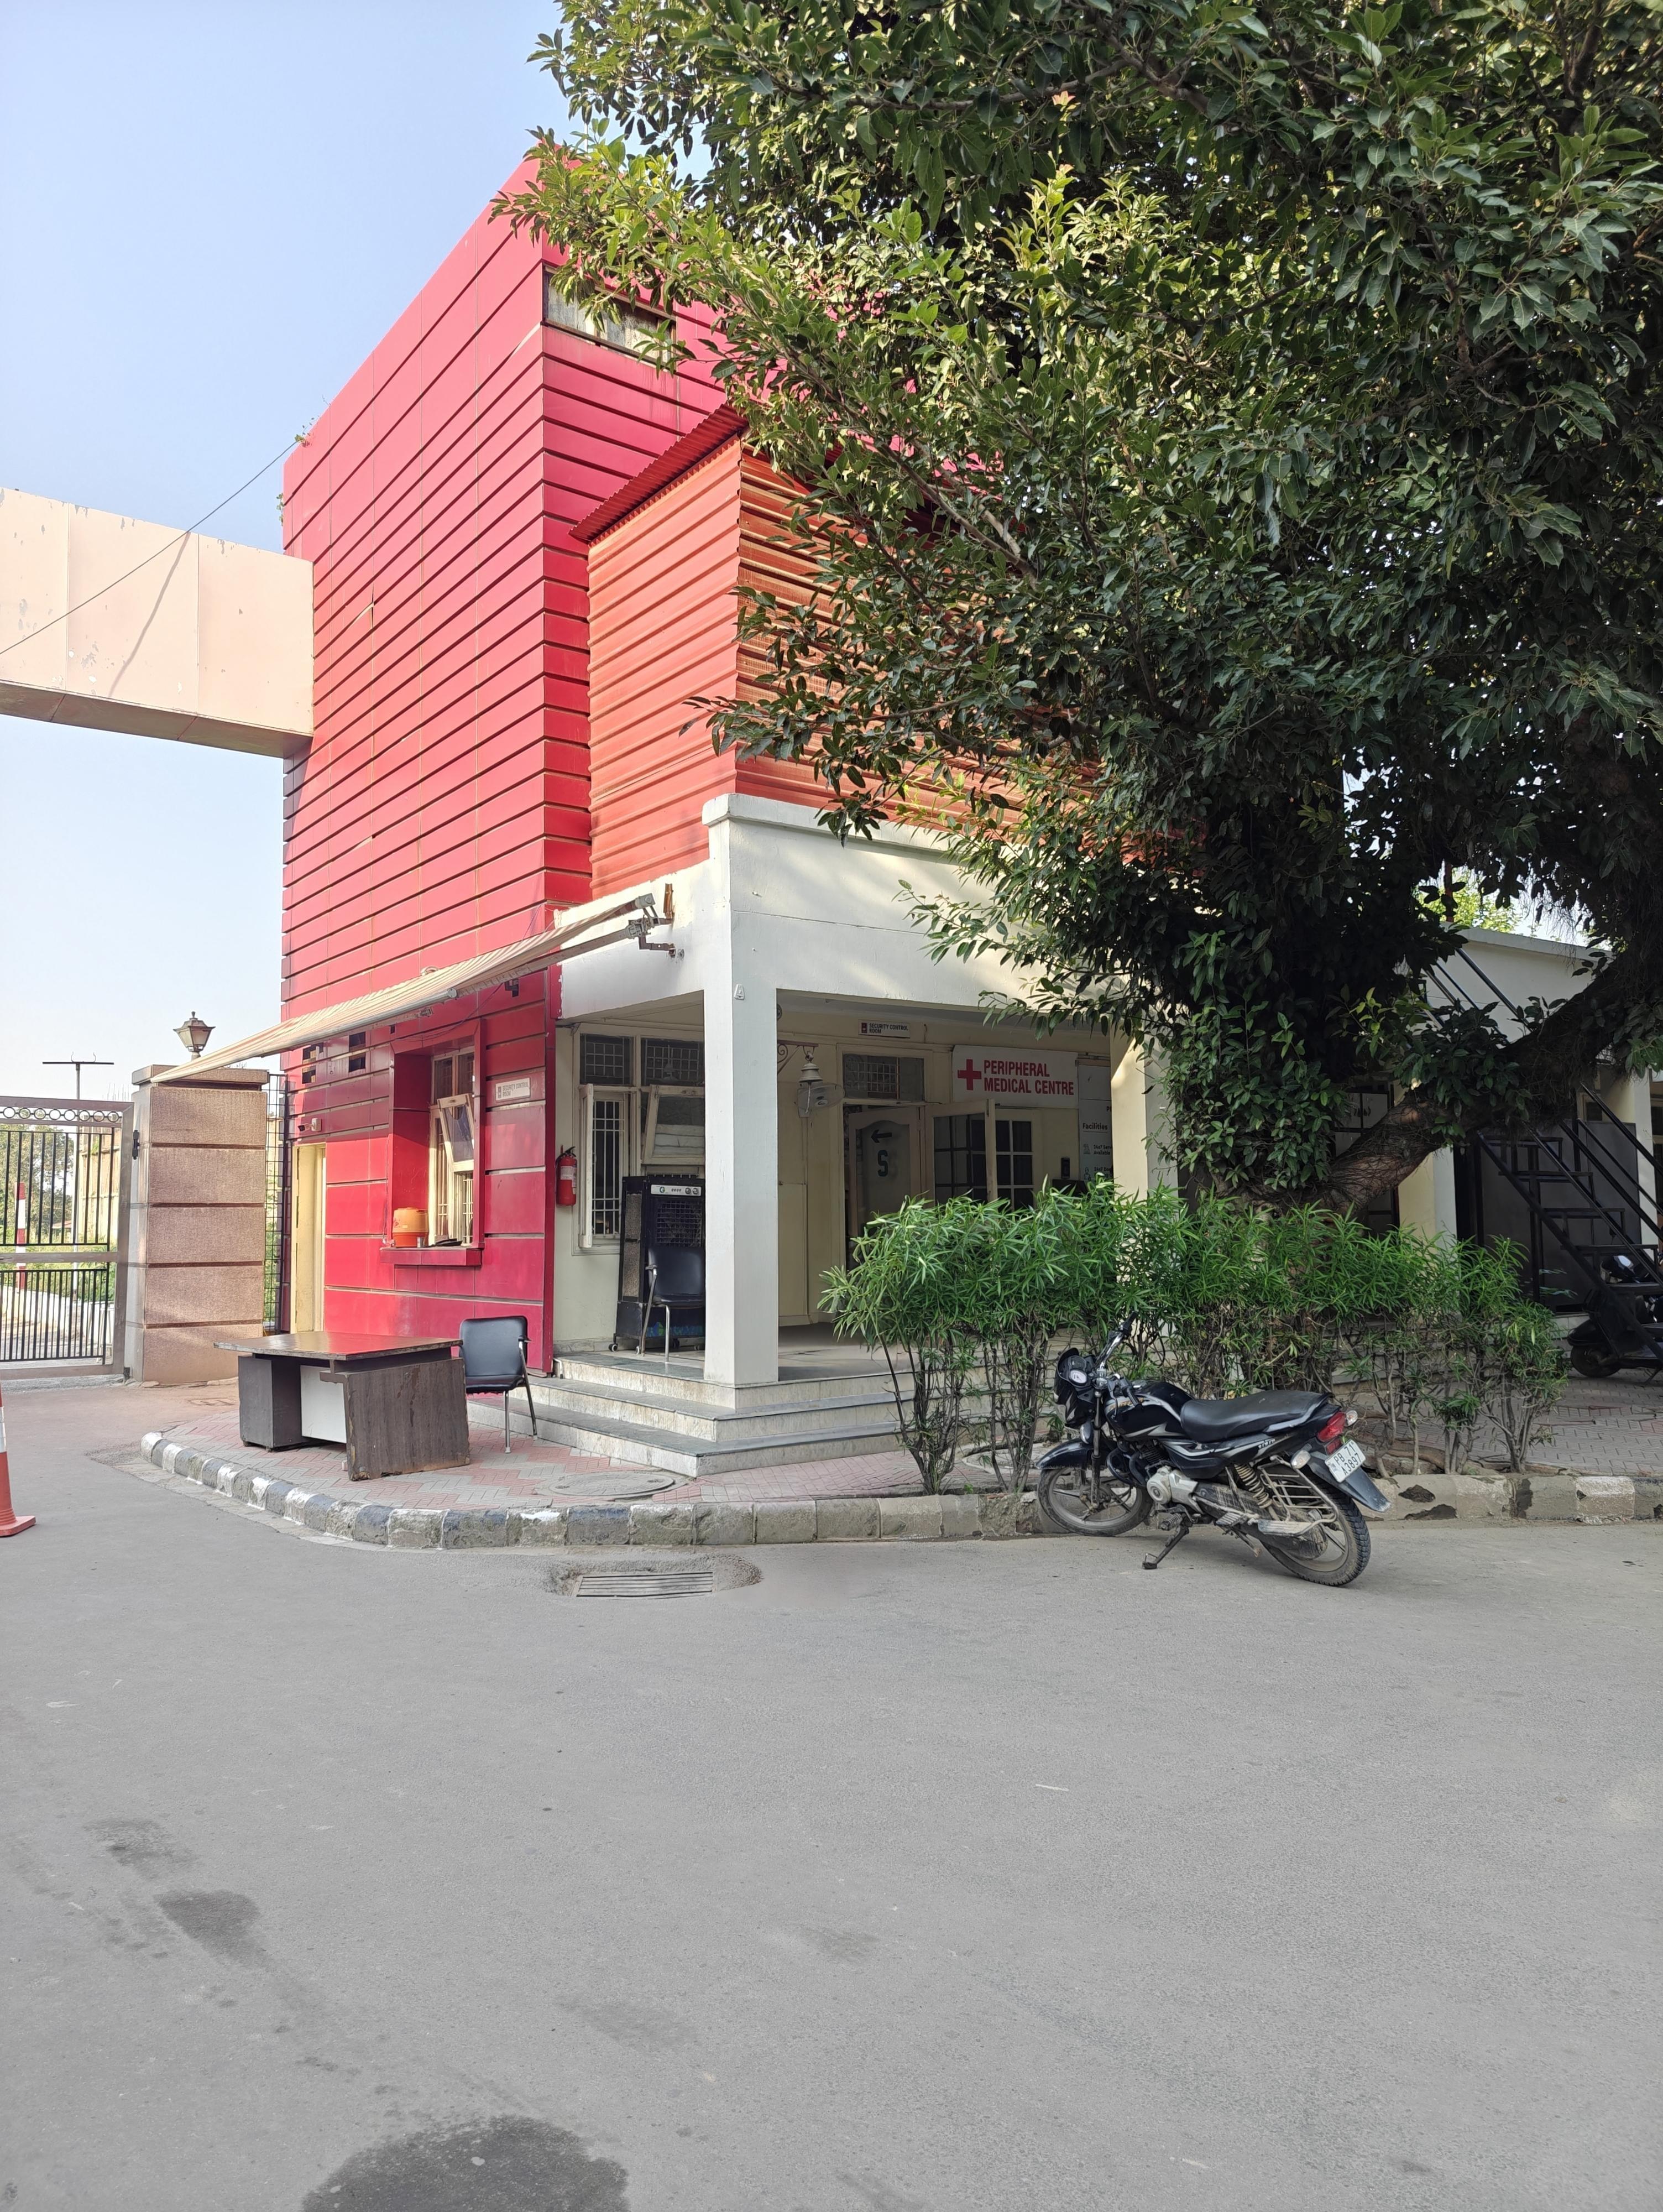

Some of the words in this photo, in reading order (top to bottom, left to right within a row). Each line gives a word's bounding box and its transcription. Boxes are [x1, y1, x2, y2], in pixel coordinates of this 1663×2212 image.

[984, 1060, 1050, 1077] PERIPHERAL
[984, 1078, 1032, 1093] MEDICAL
[1035, 1079, 1074, 1095] CENTRE
[877, 1150, 888, 1177] S
[1333, 1453, 1345, 1465] PB
[1344, 1444, 1356, 1457] 71
[1341, 1453, 1361, 1475] A3897
